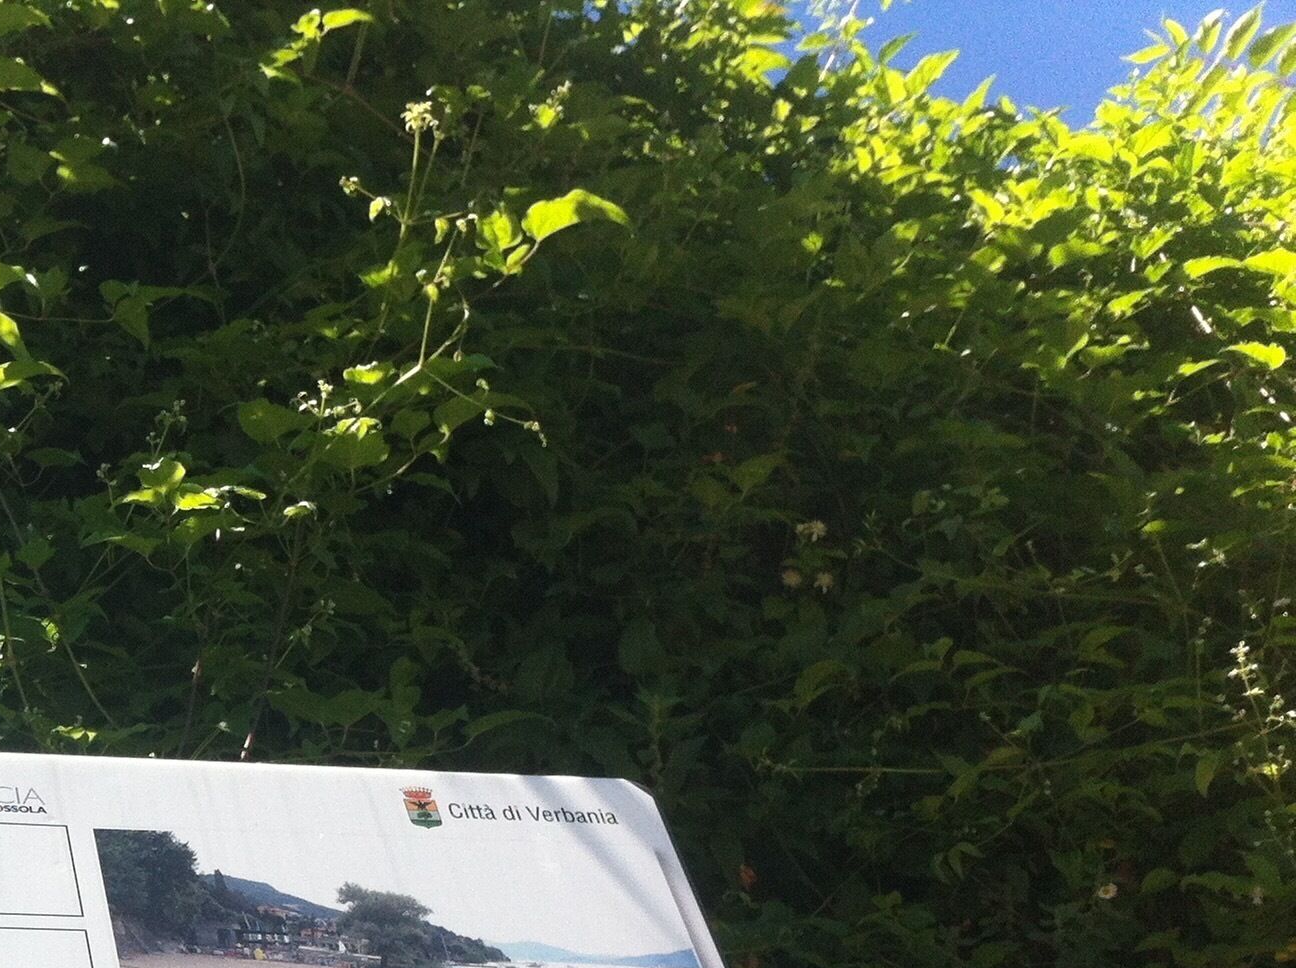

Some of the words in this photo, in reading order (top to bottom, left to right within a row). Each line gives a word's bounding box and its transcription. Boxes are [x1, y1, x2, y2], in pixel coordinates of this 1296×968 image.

[448, 802, 497, 821] Città
[502, 805, 522, 821] di
[524, 805, 619, 825] Verbania
